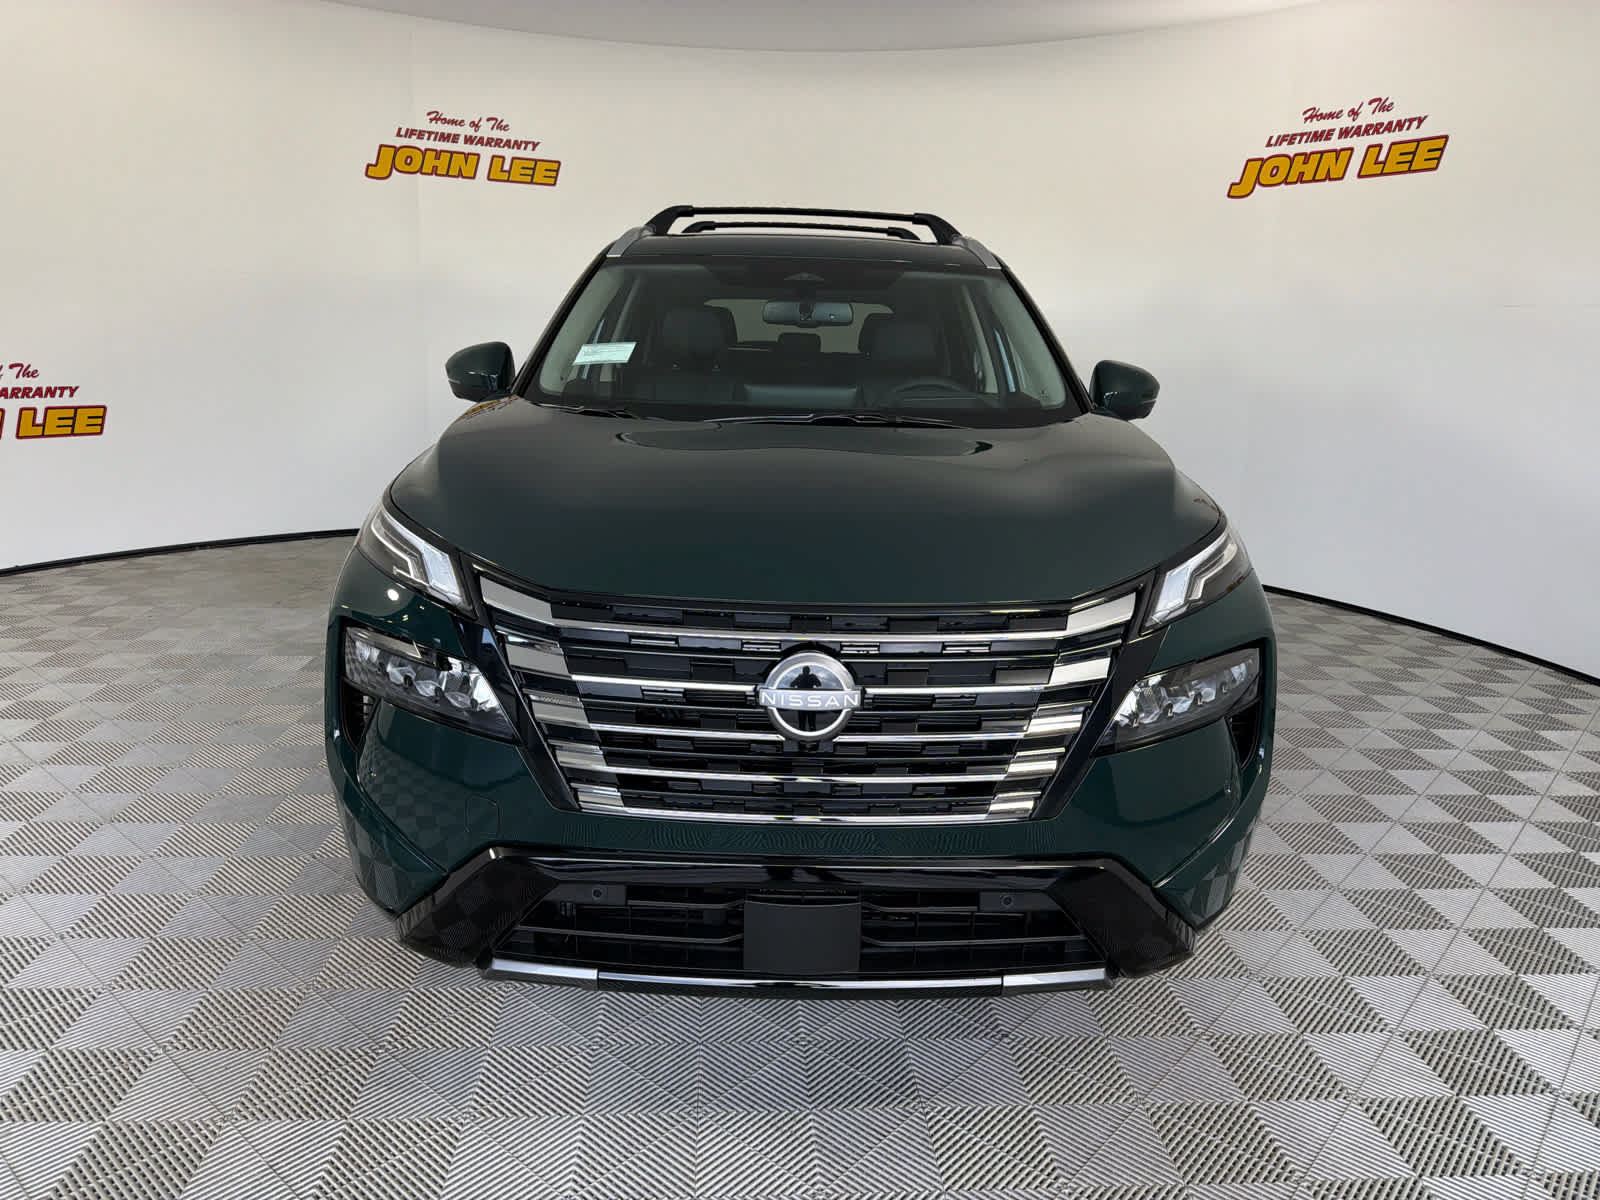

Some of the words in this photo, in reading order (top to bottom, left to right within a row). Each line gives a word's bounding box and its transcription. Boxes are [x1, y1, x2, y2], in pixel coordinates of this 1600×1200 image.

[426, 110, 465, 127] Home
[469, 116, 482, 133] of
[486, 117, 510, 132] The
[1302, 106, 1343, 124] Home
[1347, 102, 1364, 122] of
[1368, 96, 1395, 114] The
[396, 127, 461, 144] LIFETIME
[463, 134, 540, 151] WARRANTY
[1265, 128, 1335, 147] LIFETIME
[1338, 115, 1428, 140] WARRANTY
[365, 144, 480, 180] JOHN
[487, 155, 561, 186] LEE
[1227, 147, 1354, 199] JOHN
[1357, 135, 1449, 179] LEE
[8, 362, 40, 379] The
[0, 385, 80, 399] ARRANTY
[16, 404, 107, 440] LEE
[761, 691, 859, 708] NISSAN
